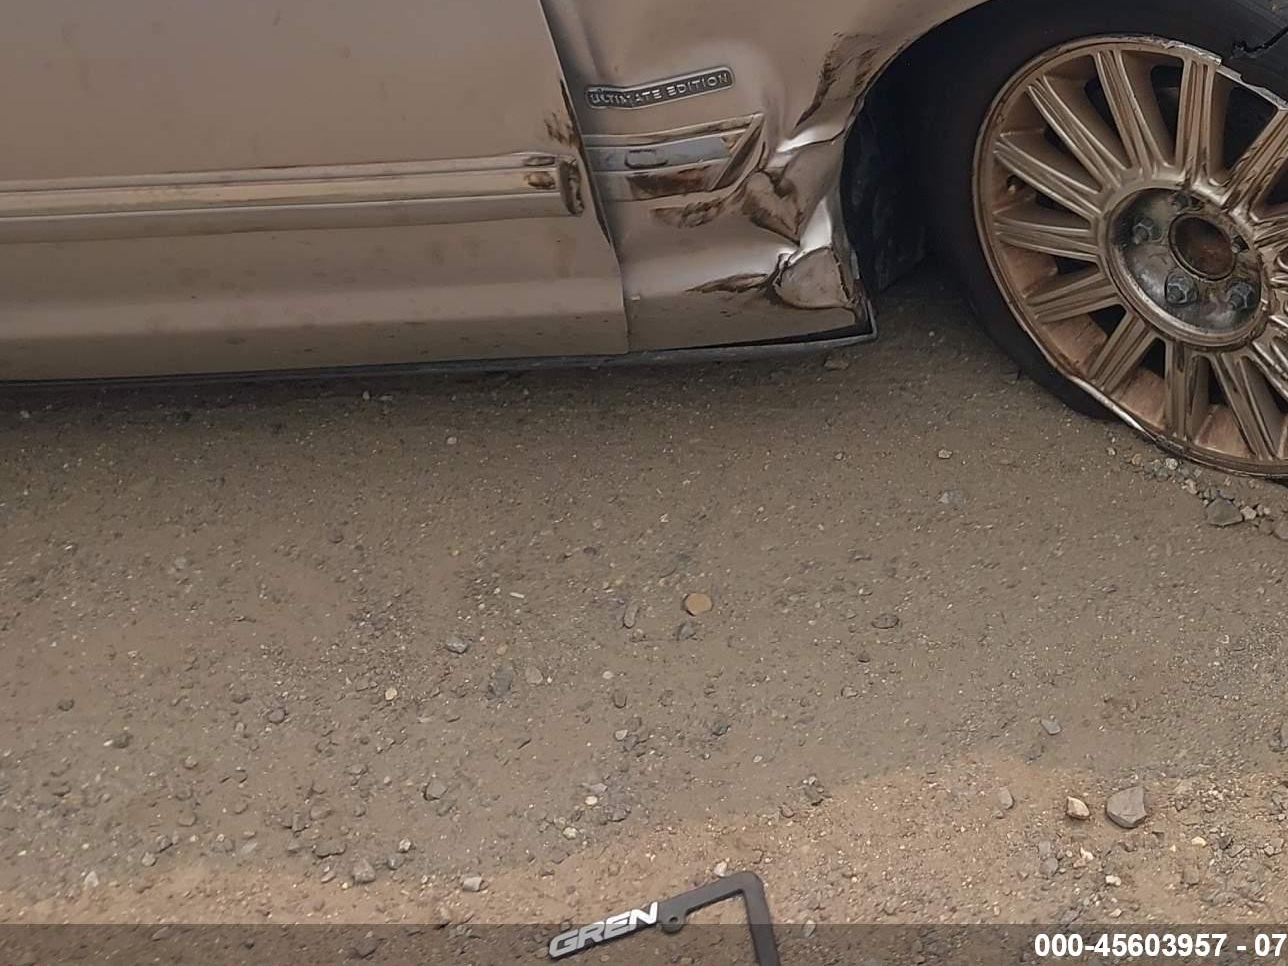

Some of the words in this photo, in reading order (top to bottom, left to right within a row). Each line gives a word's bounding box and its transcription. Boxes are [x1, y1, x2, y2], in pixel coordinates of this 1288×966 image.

[589, 89, 662, 105] ULTIMATE
[666, 73, 728, 96] EDITION
[549, 901, 658, 958] GREN
